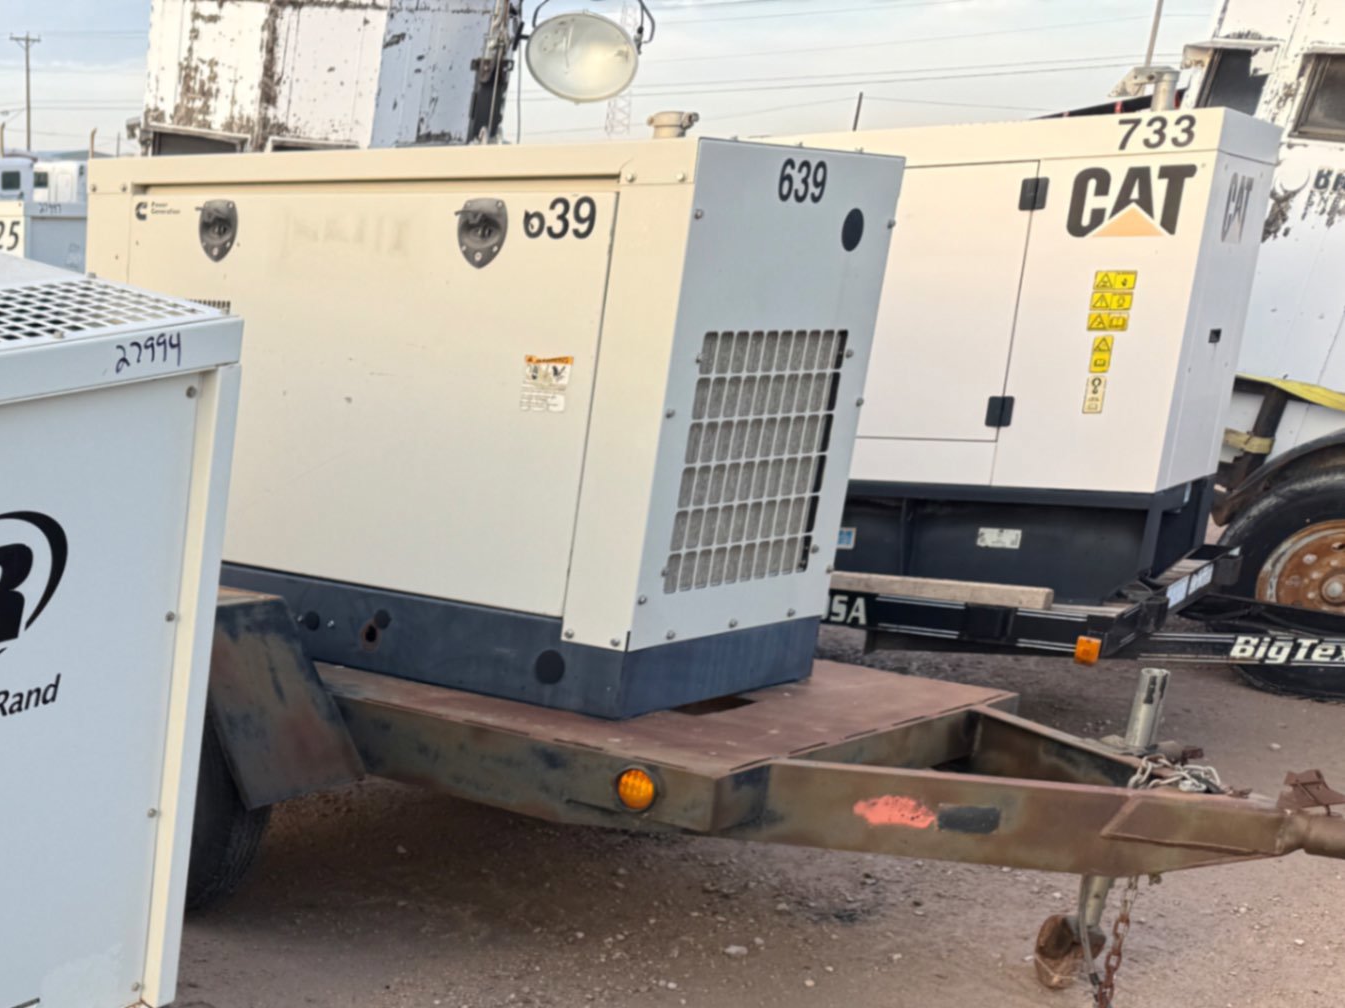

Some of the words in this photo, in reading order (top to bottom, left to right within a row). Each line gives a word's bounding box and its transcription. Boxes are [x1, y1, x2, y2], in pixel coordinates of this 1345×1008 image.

[1118, 114, 1197, 151] 733
[778, 157, 828, 204] 639
[1066, 164, 1197, 238] CAT
[1221, 172, 1254, 243] CAT
[115, 331, 183, 374] 27994
[822, 593, 867, 625] SA
